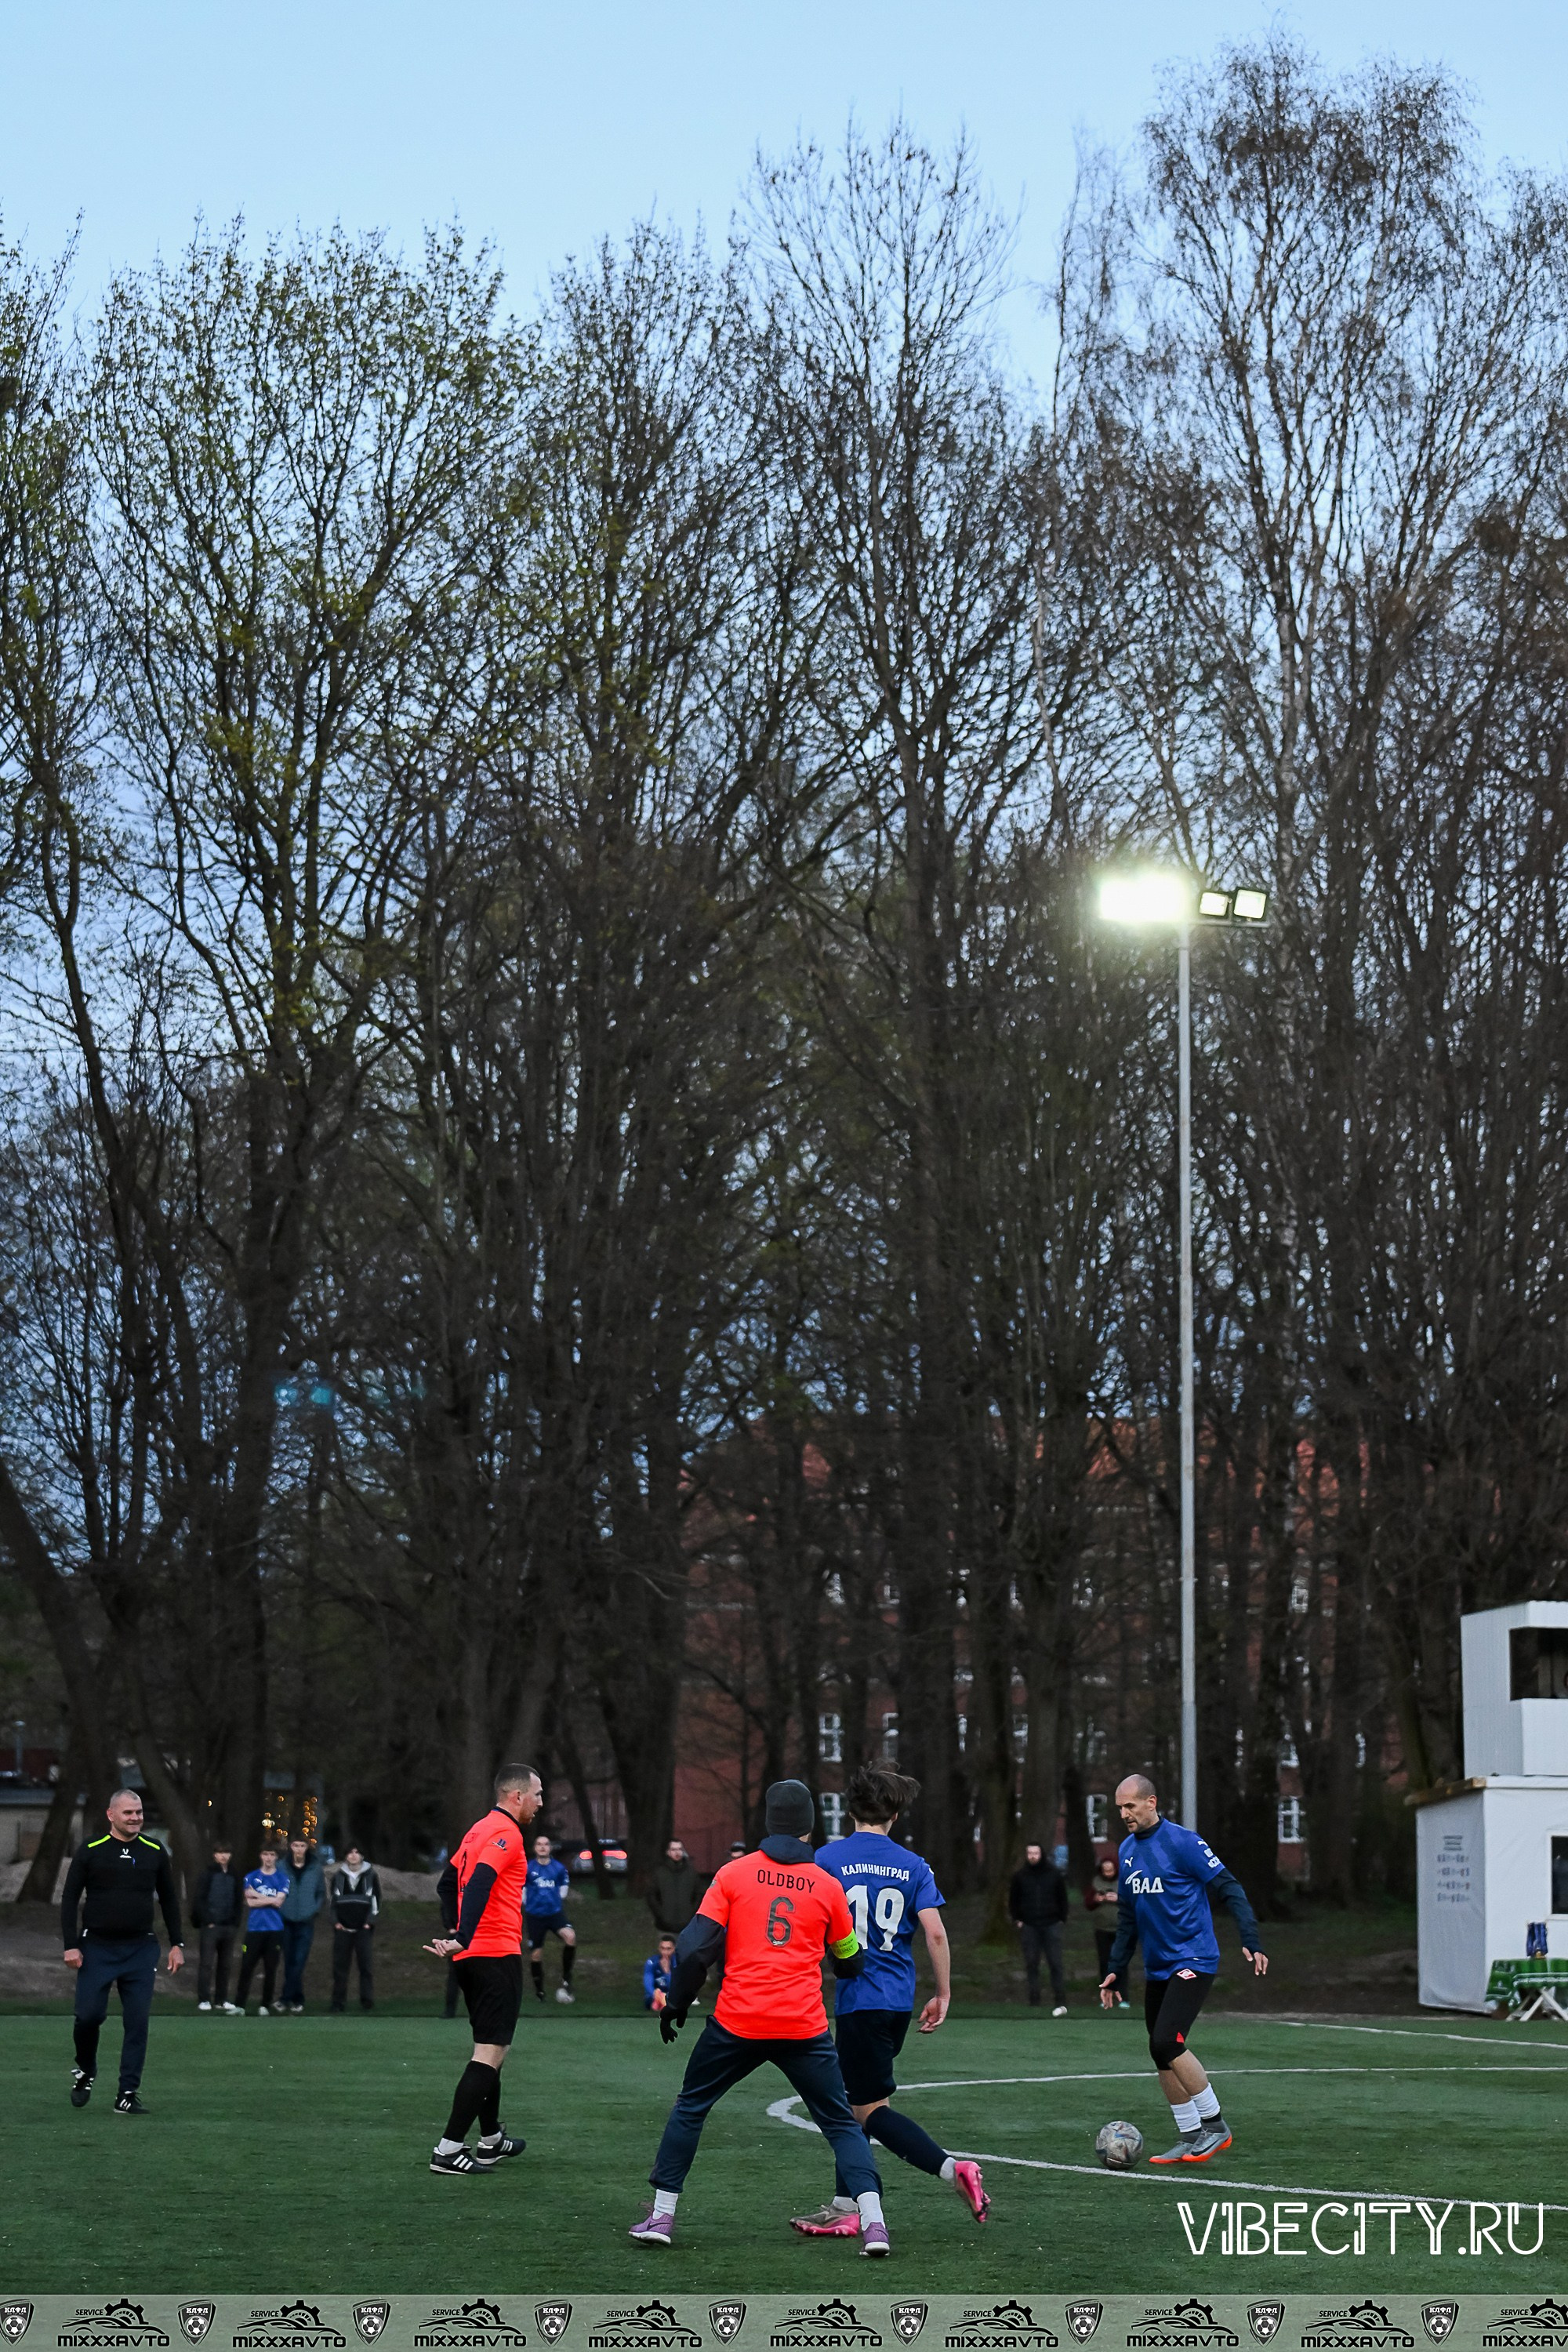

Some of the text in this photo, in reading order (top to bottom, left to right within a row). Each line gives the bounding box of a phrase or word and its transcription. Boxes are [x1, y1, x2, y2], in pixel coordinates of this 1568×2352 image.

[757, 1869, 815, 1893] OLDBOY
[840, 1863, 909, 1882] КАЛИНИНГРАД
[767, 1896, 794, 1946] 6
[846, 1885, 905, 1951] 19
